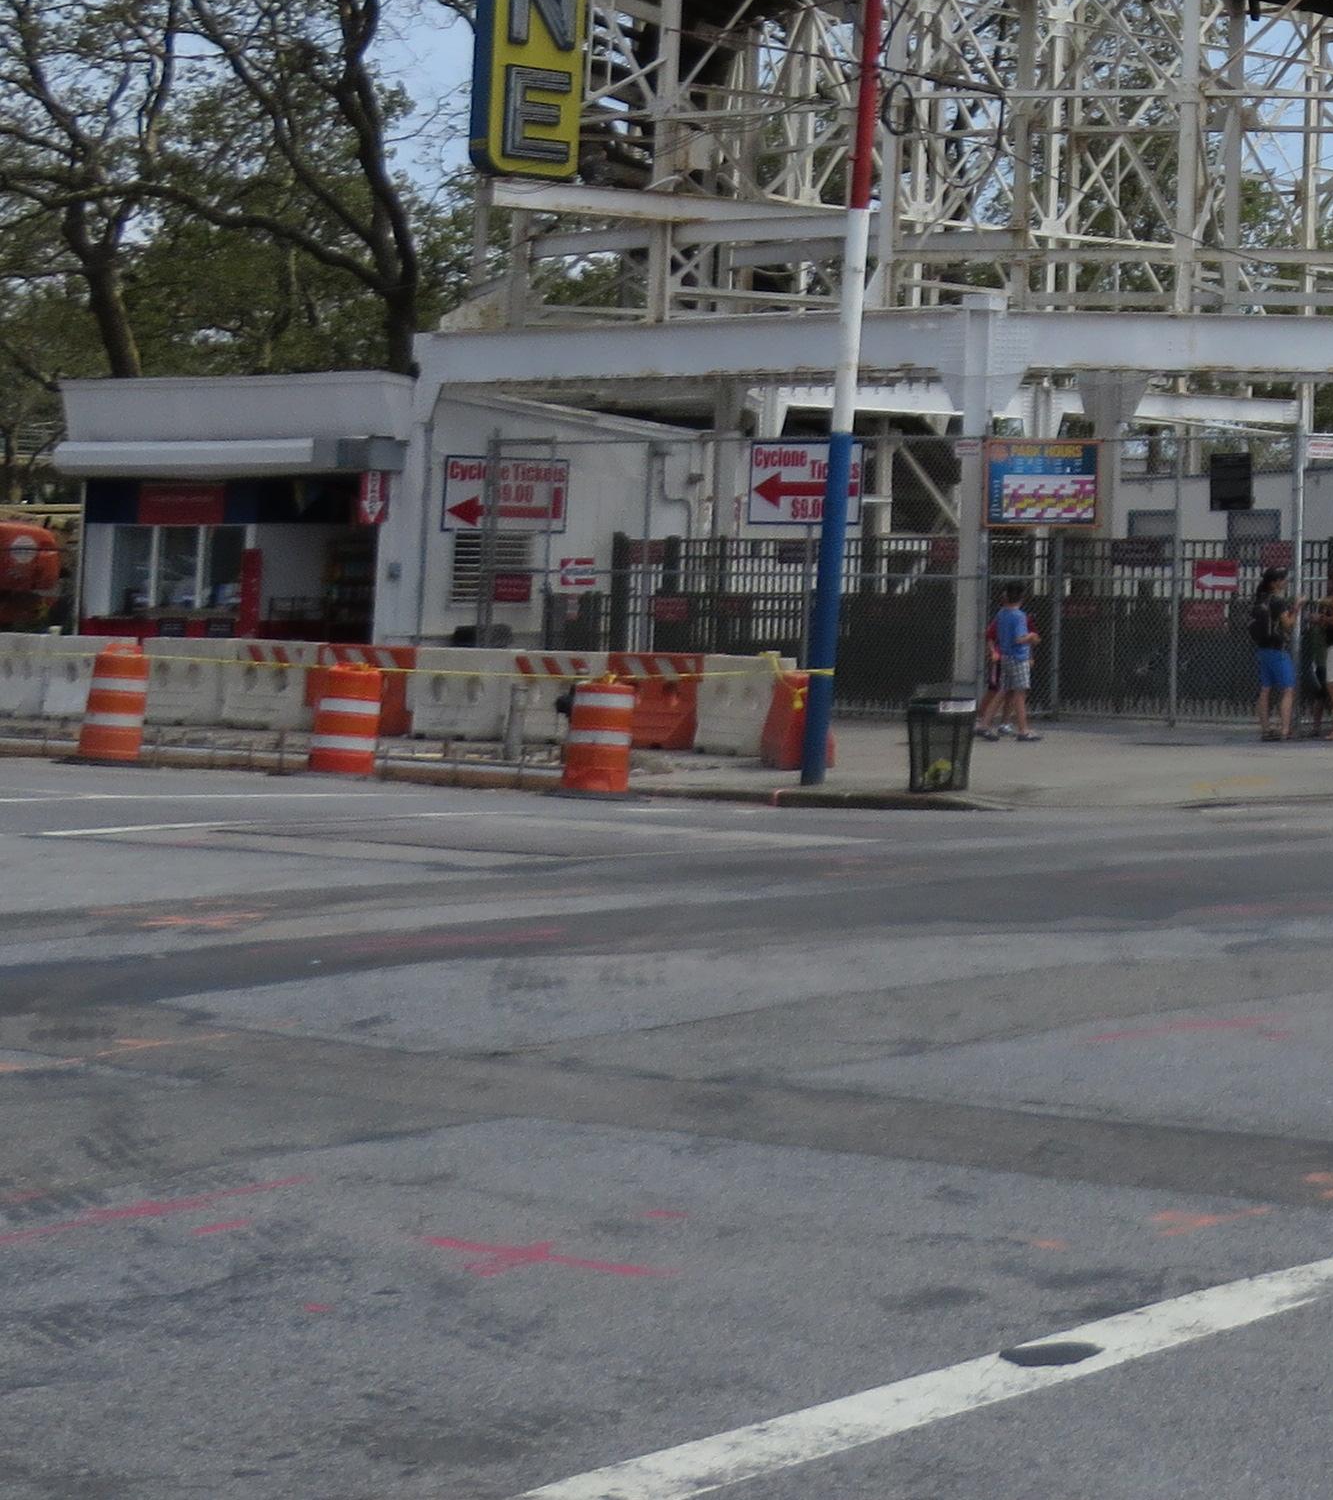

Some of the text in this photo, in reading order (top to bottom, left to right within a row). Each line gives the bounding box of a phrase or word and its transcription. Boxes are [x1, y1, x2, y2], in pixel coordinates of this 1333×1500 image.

[754, 446, 807, 469] Cyclone
[1043, 444, 1082, 458] HOURS
[449, 460, 566, 483] Cycle Tickets
[810, 460, 860, 480] Tics
[791, 498, 824, 519] $9.0
